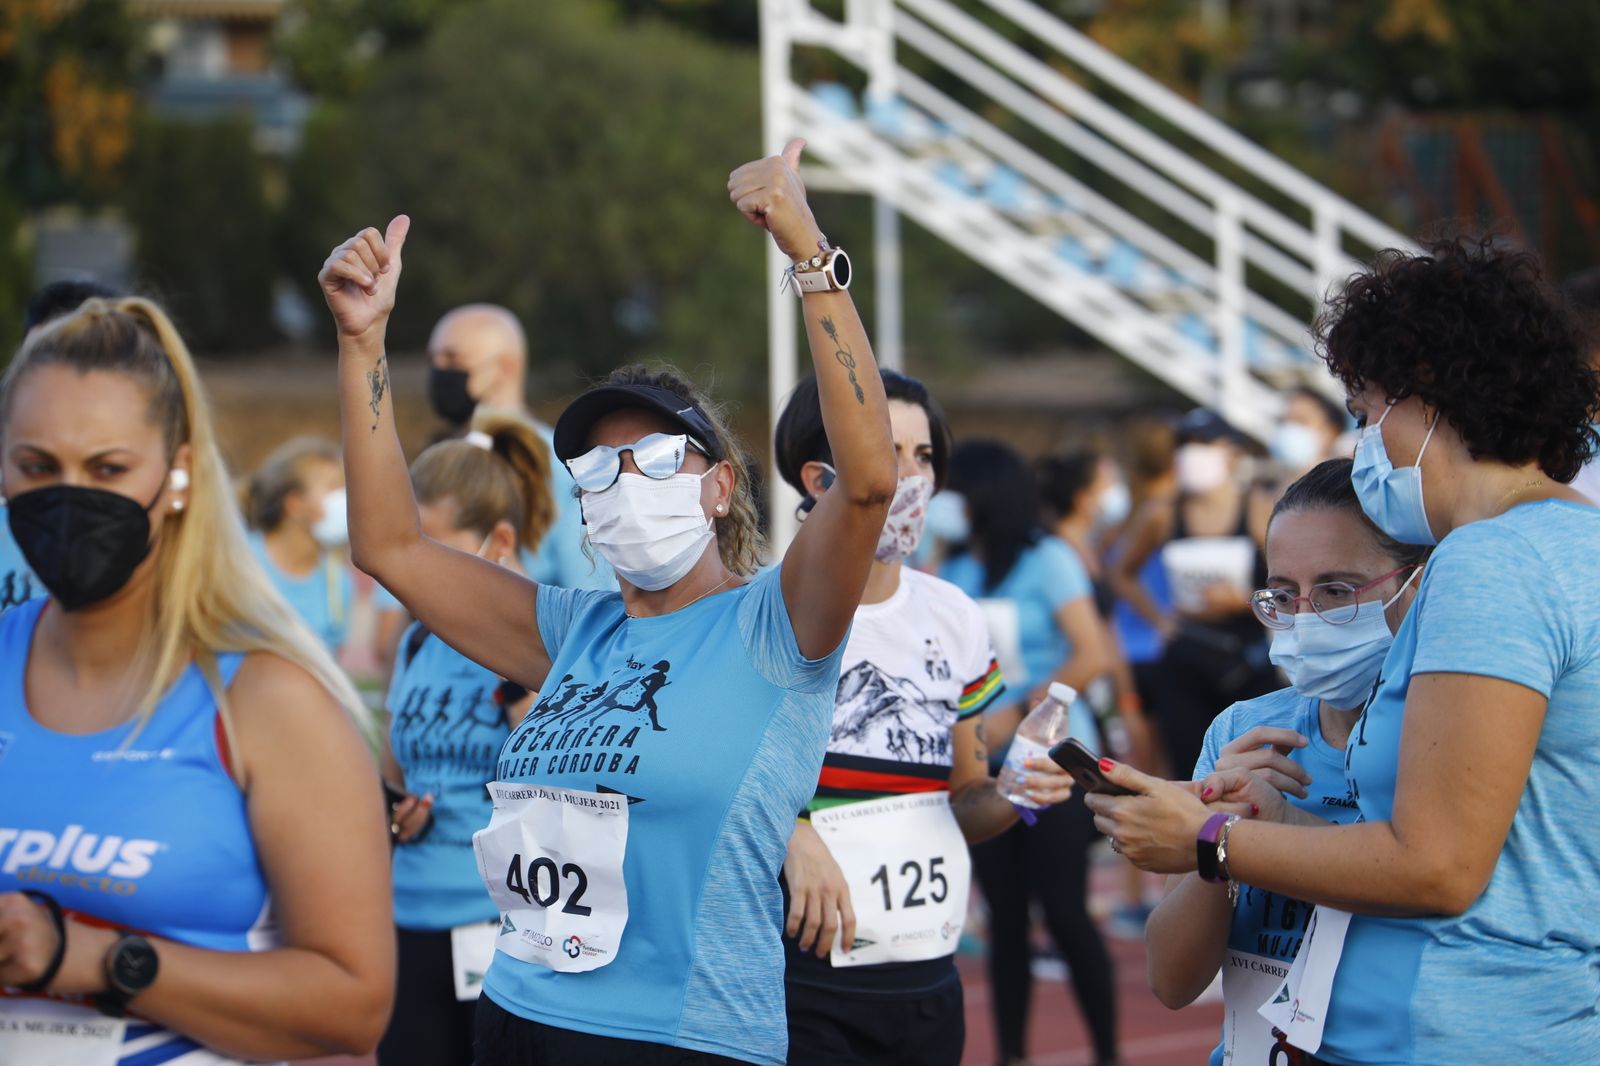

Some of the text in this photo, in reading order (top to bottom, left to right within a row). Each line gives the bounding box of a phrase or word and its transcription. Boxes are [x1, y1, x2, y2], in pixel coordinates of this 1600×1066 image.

[547, 749, 640, 775] CÓRDOBA
[563, 794, 597, 808] MUJER
[599, 799, 620, 810] 2021
[841, 806, 890, 819] CARRERA
[506, 853, 591, 917] 402
[870, 856, 948, 911] 125
[1258, 933, 1303, 958] MUJE
[1231, 956, 1289, 978] XVI CARRER
